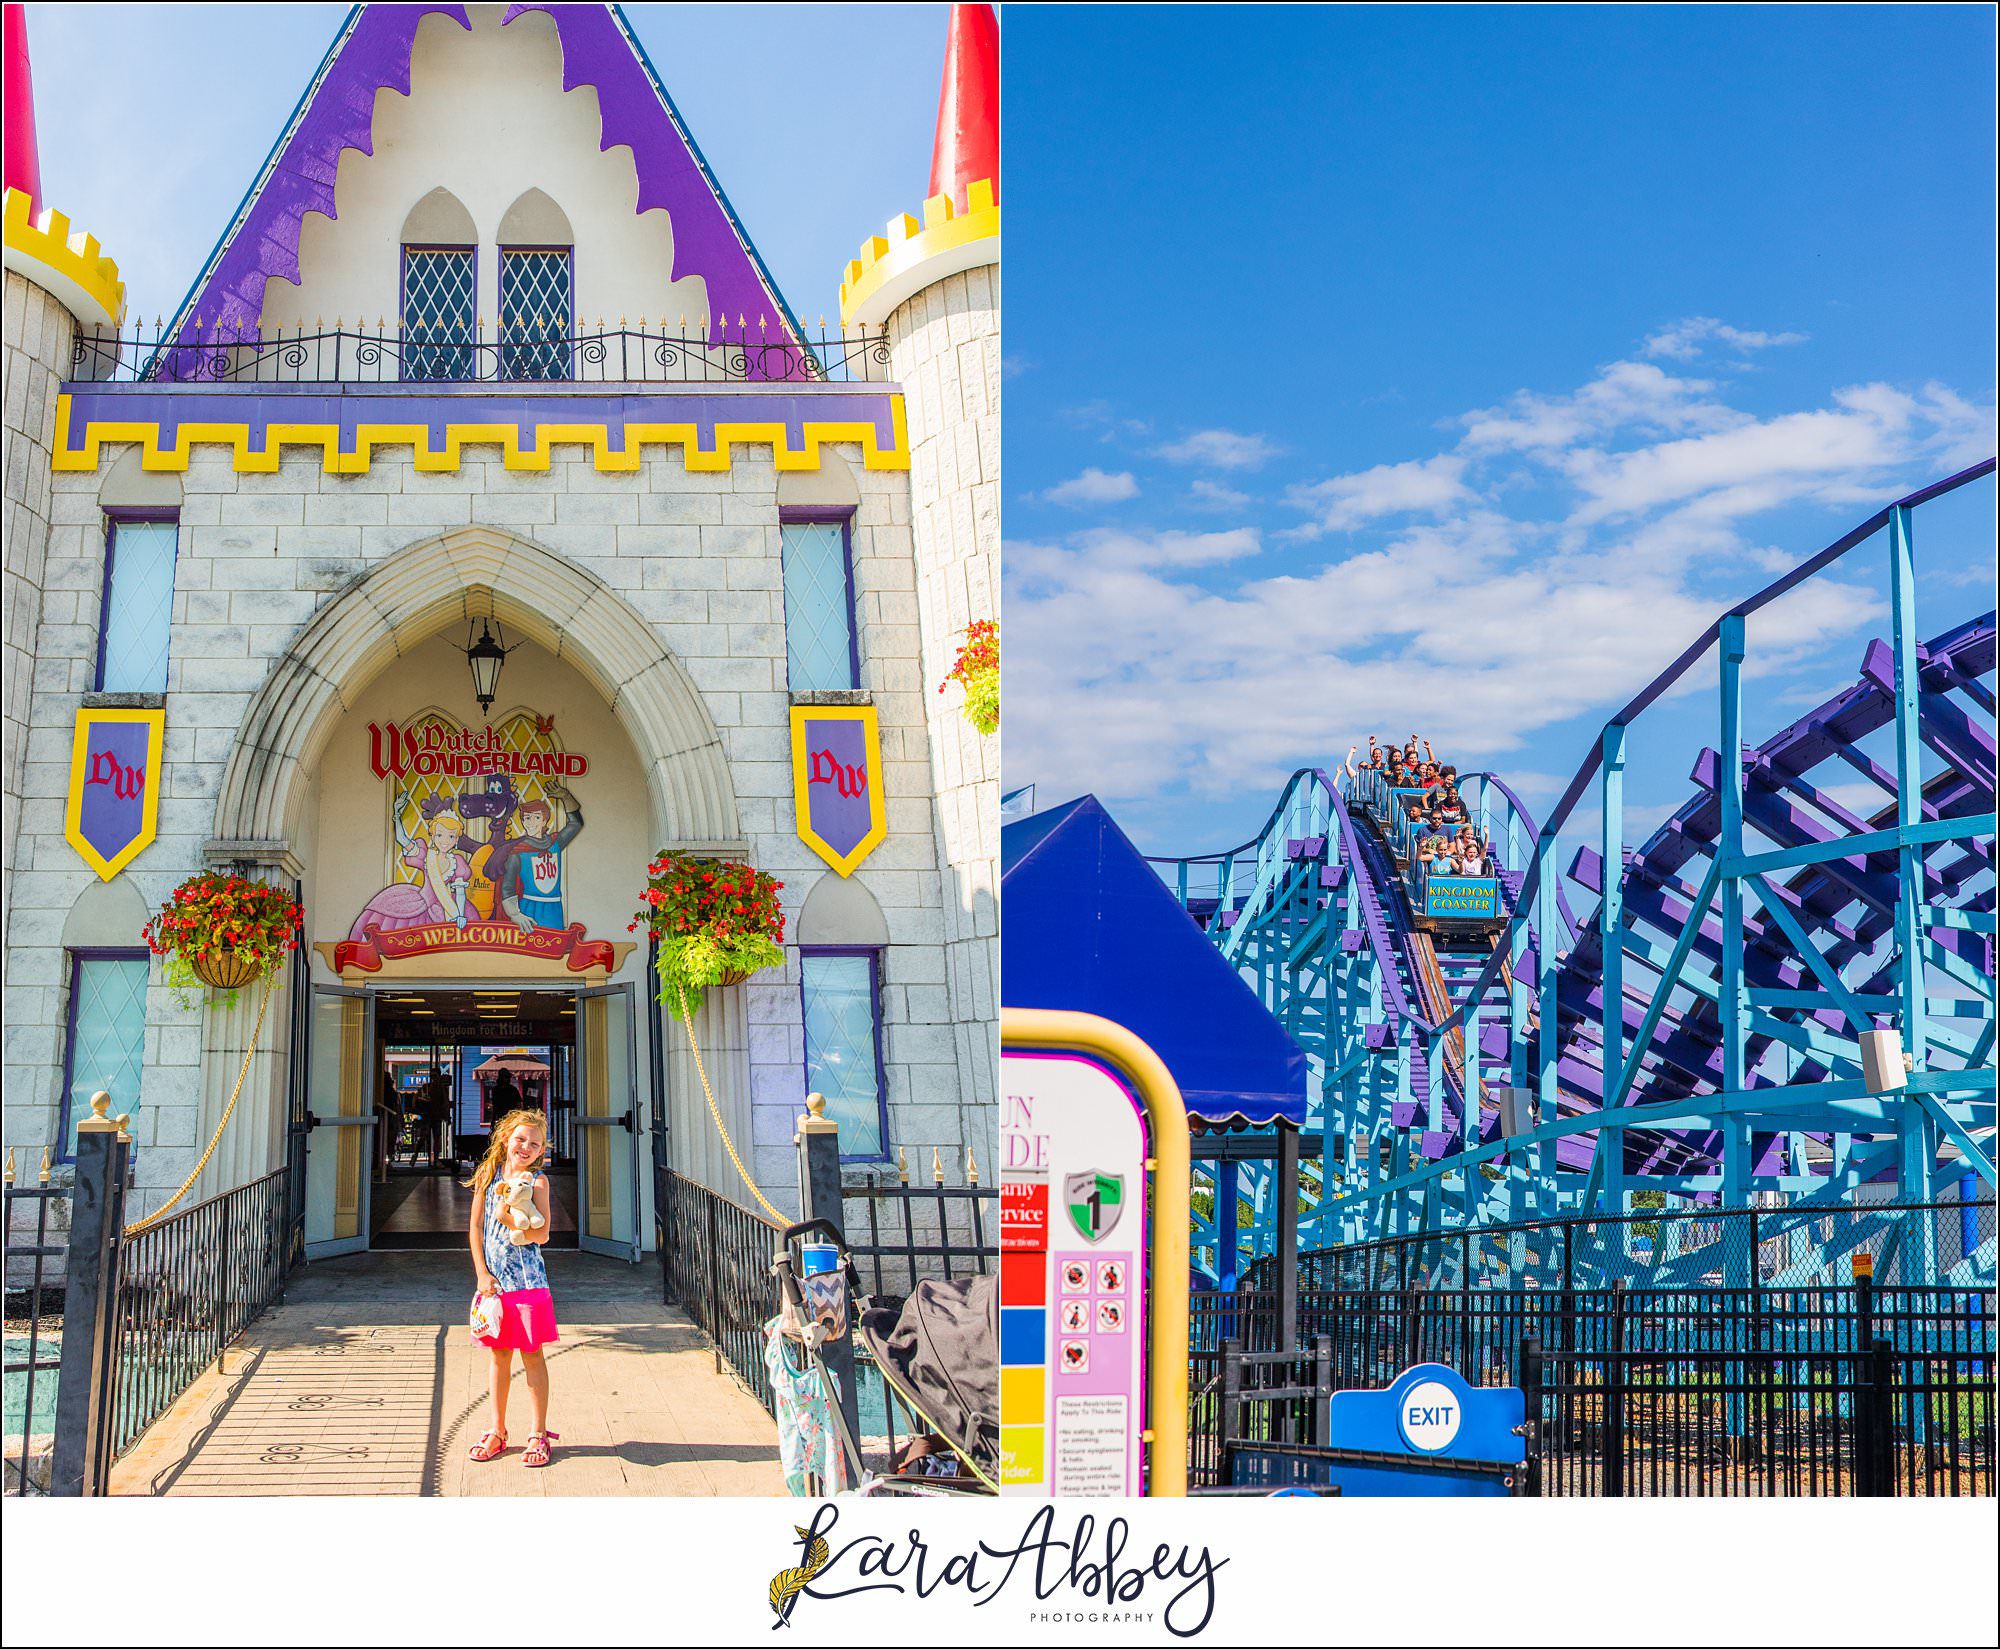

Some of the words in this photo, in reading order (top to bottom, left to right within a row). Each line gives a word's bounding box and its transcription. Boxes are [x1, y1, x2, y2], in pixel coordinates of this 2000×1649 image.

[422, 722, 503, 752] Dutch
[368, 721, 588, 781] WONDERLAND
[86, 750, 145, 801] DW
[808, 748, 867, 799] DW
[1429, 885, 1494, 898] KINGDOM
[1432, 898, 1489, 911] COASTER
[422, 926, 527, 946] WELCOME
[431, 1021, 476, 1038] Kingdom
[480, 1022, 496, 1035] for
[500, 1021, 533, 1035] Kids!
[1087, 1190, 1101, 1230] 1
[1408, 1407, 1453, 1426] EXIT
